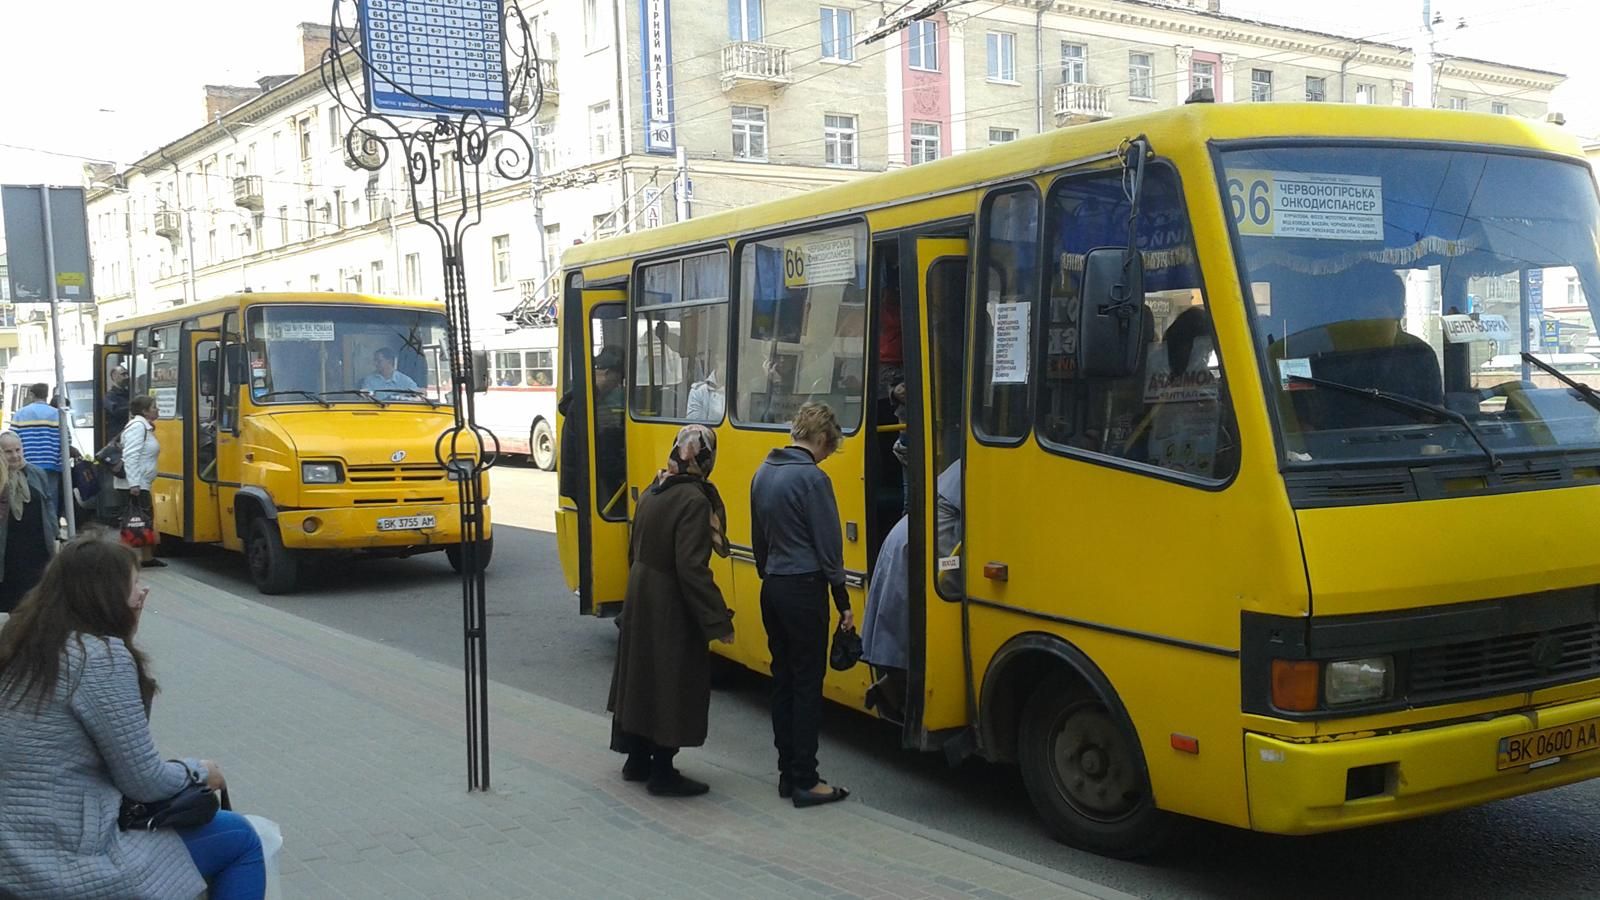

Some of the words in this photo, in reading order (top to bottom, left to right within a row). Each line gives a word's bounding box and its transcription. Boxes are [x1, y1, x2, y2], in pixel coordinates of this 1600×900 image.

[372, 10, 384, 18] 64
[374, 32, 386, 40] 66
[1280, 184, 1376, 198] ЧЕРВОНОГІРСЬКА
[1227, 178, 1271, 226] 66
[1281, 197, 1376, 212] ОНКОДИСПАНСЕР
[786, 246, 804, 279] 66
[384, 520, 396, 528] BK
[399, 518, 418, 528] 3755
[422, 517, 434, 526] AM
[1509, 736, 1533, 762] BK
[1536, 728, 1573, 756] 0600
[1577, 724, 1597, 747] AA
